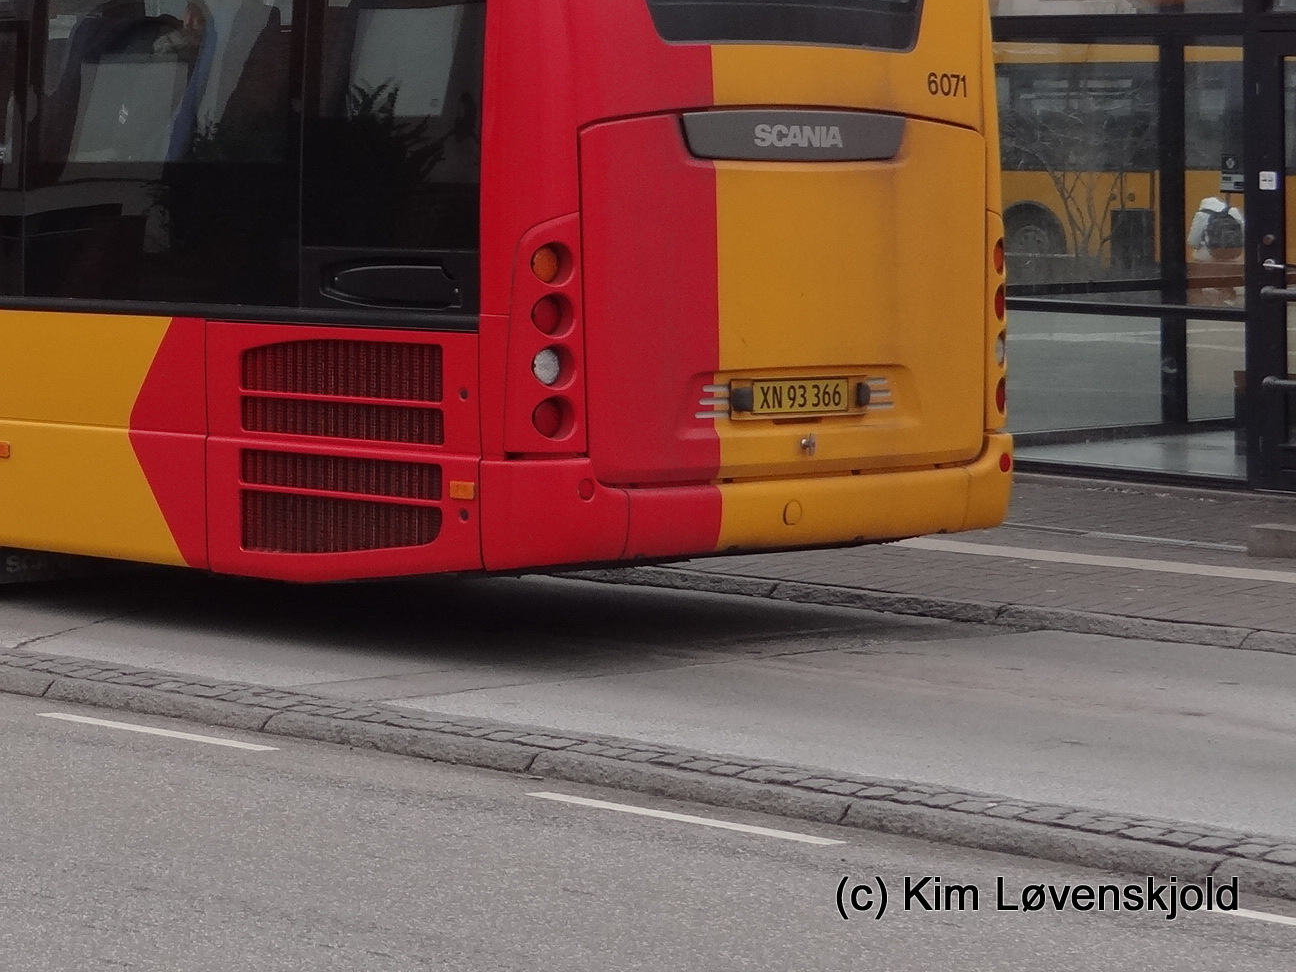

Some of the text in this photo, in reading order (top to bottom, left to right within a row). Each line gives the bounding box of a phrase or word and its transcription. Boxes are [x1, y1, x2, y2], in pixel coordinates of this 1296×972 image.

[927, 71, 969, 98] 6071
[753, 123, 844, 150] SCANIA
[759, 382, 842, 410] XN 93 366
